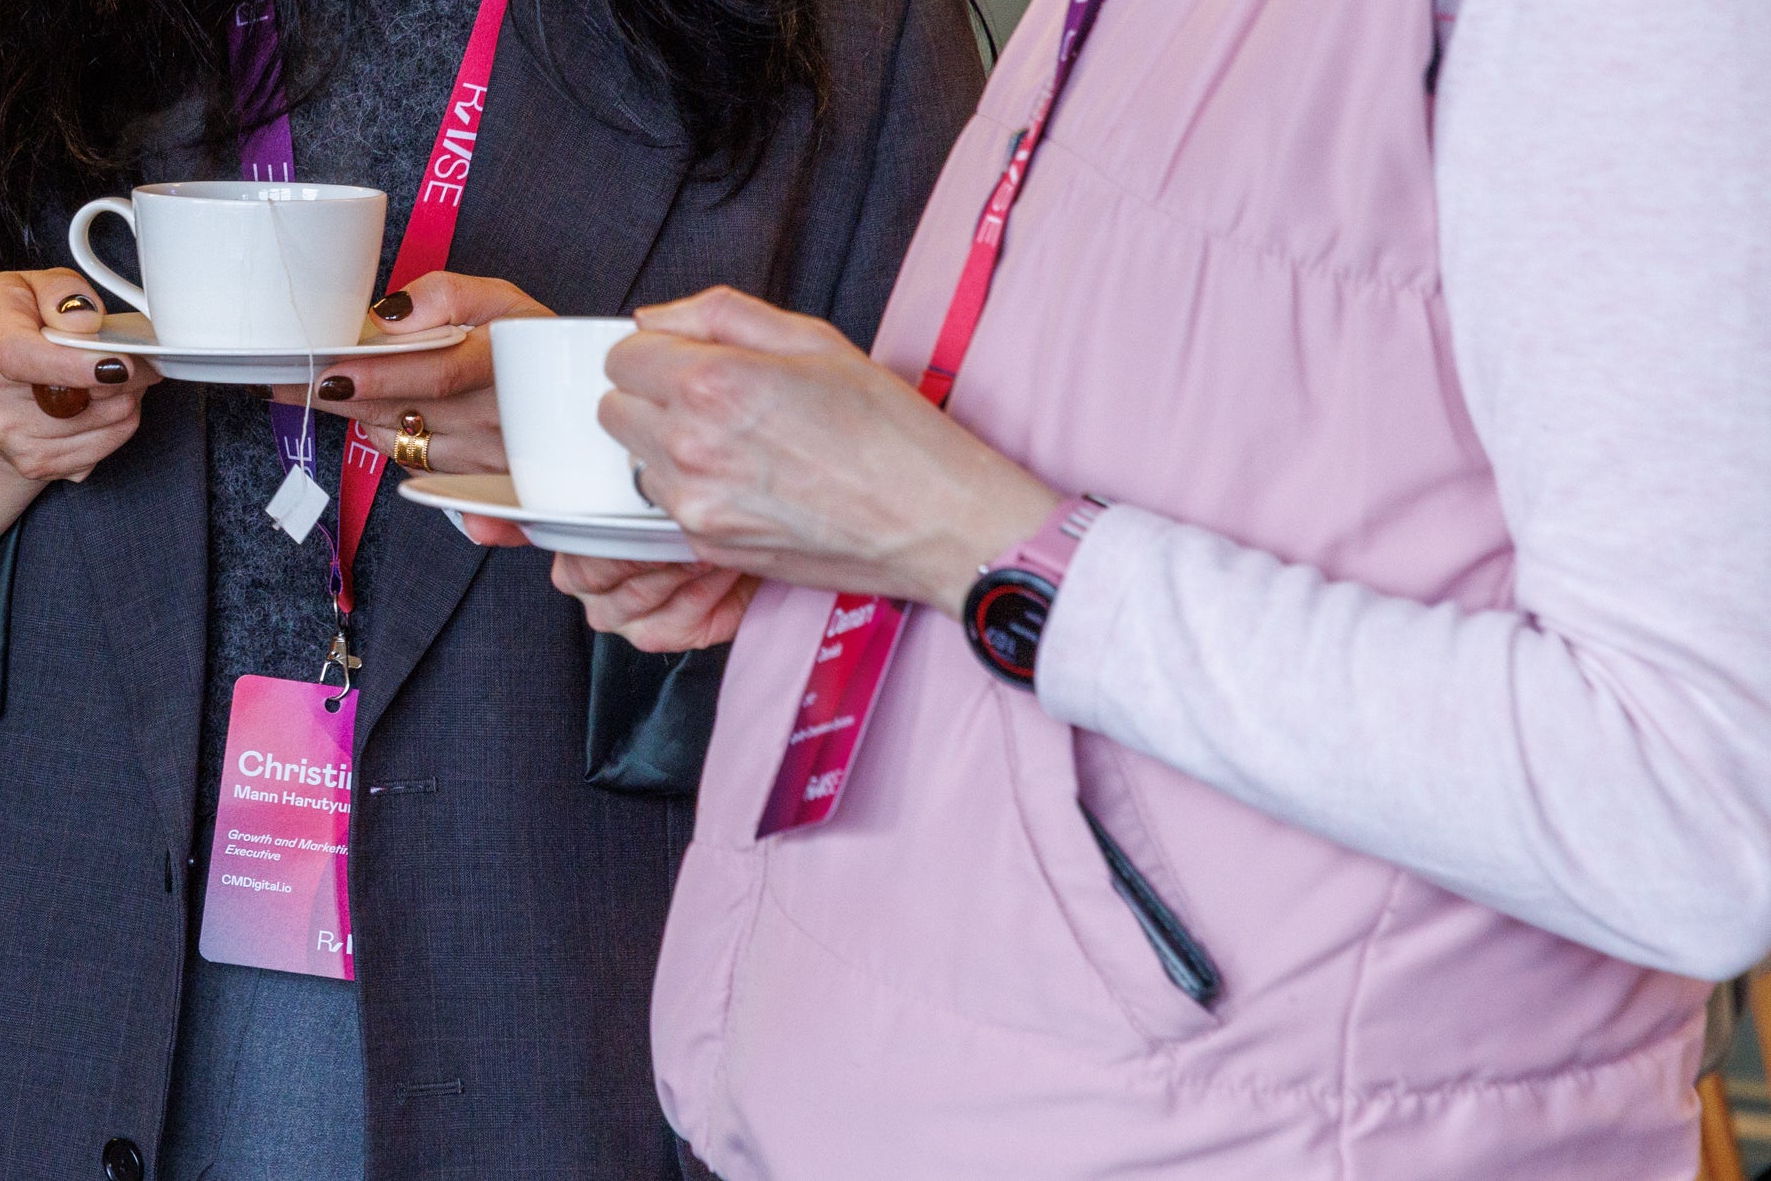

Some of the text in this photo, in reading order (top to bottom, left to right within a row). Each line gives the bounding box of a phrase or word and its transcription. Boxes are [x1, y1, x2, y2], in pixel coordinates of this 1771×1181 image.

[233, 784, 278, 804] Mann
[227, 828, 272, 847] Growth
[274, 834, 297, 850] and
[224, 844, 281, 862] Executive
[221, 874, 292, 894] CMDigital.io
